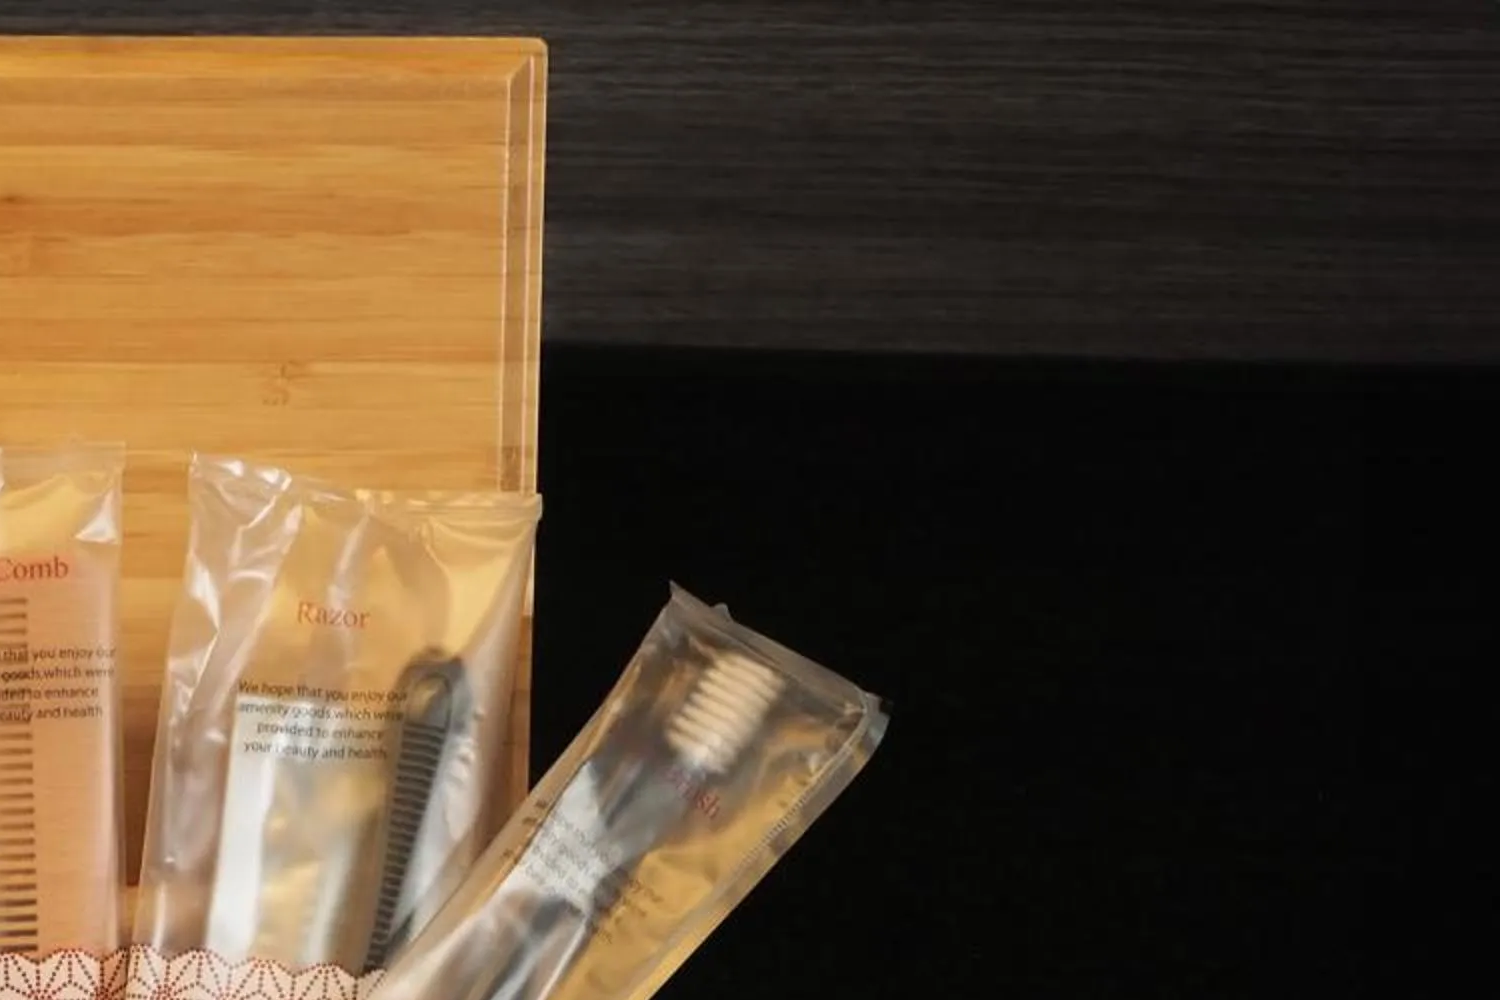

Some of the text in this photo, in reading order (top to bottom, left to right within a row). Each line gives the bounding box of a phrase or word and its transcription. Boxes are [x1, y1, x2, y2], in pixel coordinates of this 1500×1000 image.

[297, 601, 371, 628] Razor
[2, 650, 29, 664] that
[32, 651, 55, 665] you
[58, 648, 93, 662] enjoy
[25, 689, 42, 700] to
[44, 686, 99, 700] enhance
[260, 682, 293, 698] hope
[296, 685, 321, 698] that
[325, 689, 350, 703] you
[350, 690, 386, 705] enjoy
[36, 707, 62, 719] and
[257, 722, 314, 738] provided
[316, 728, 329, 739] to
[244, 742, 272, 755] your
[322, 747, 345, 759] and
